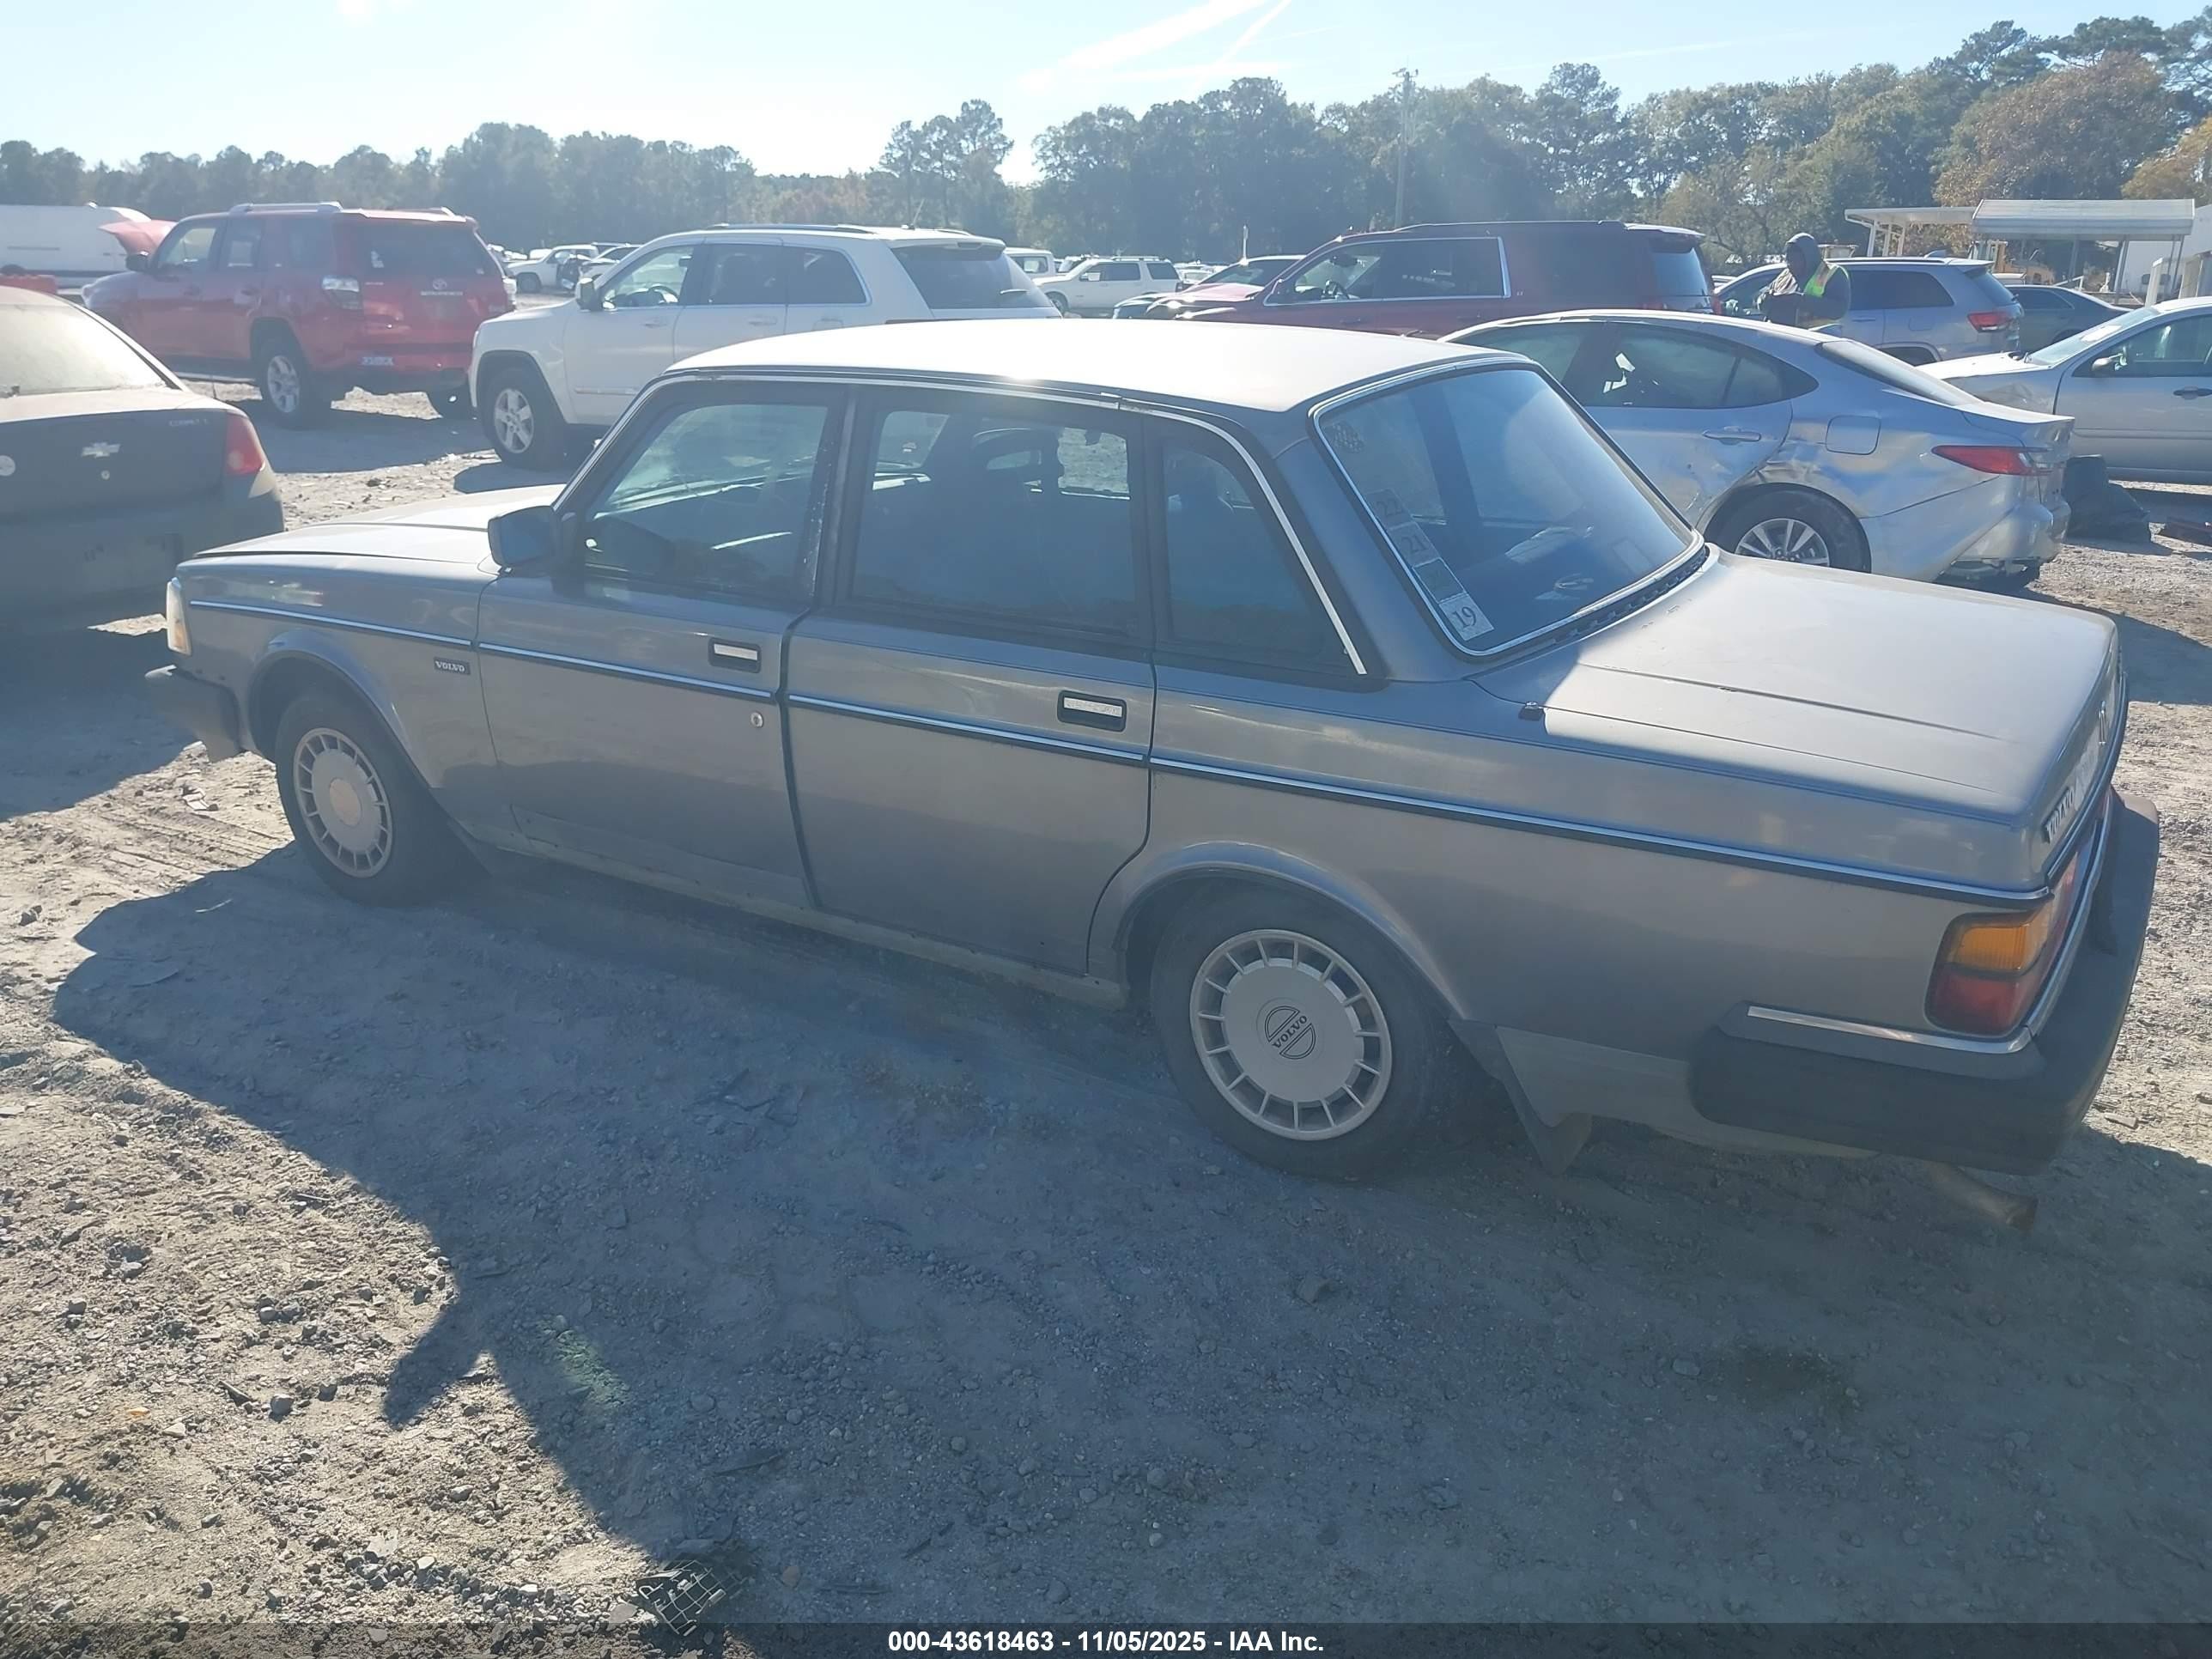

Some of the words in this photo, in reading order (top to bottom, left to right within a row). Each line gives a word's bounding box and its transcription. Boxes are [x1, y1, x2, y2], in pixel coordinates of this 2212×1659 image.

[1401, 535, 1427, 555] 21
[1452, 605, 1477, 628] 19
[435, 660, 465, 672] VOLVO
[1271, 1015, 1308, 1048] VOLVO
